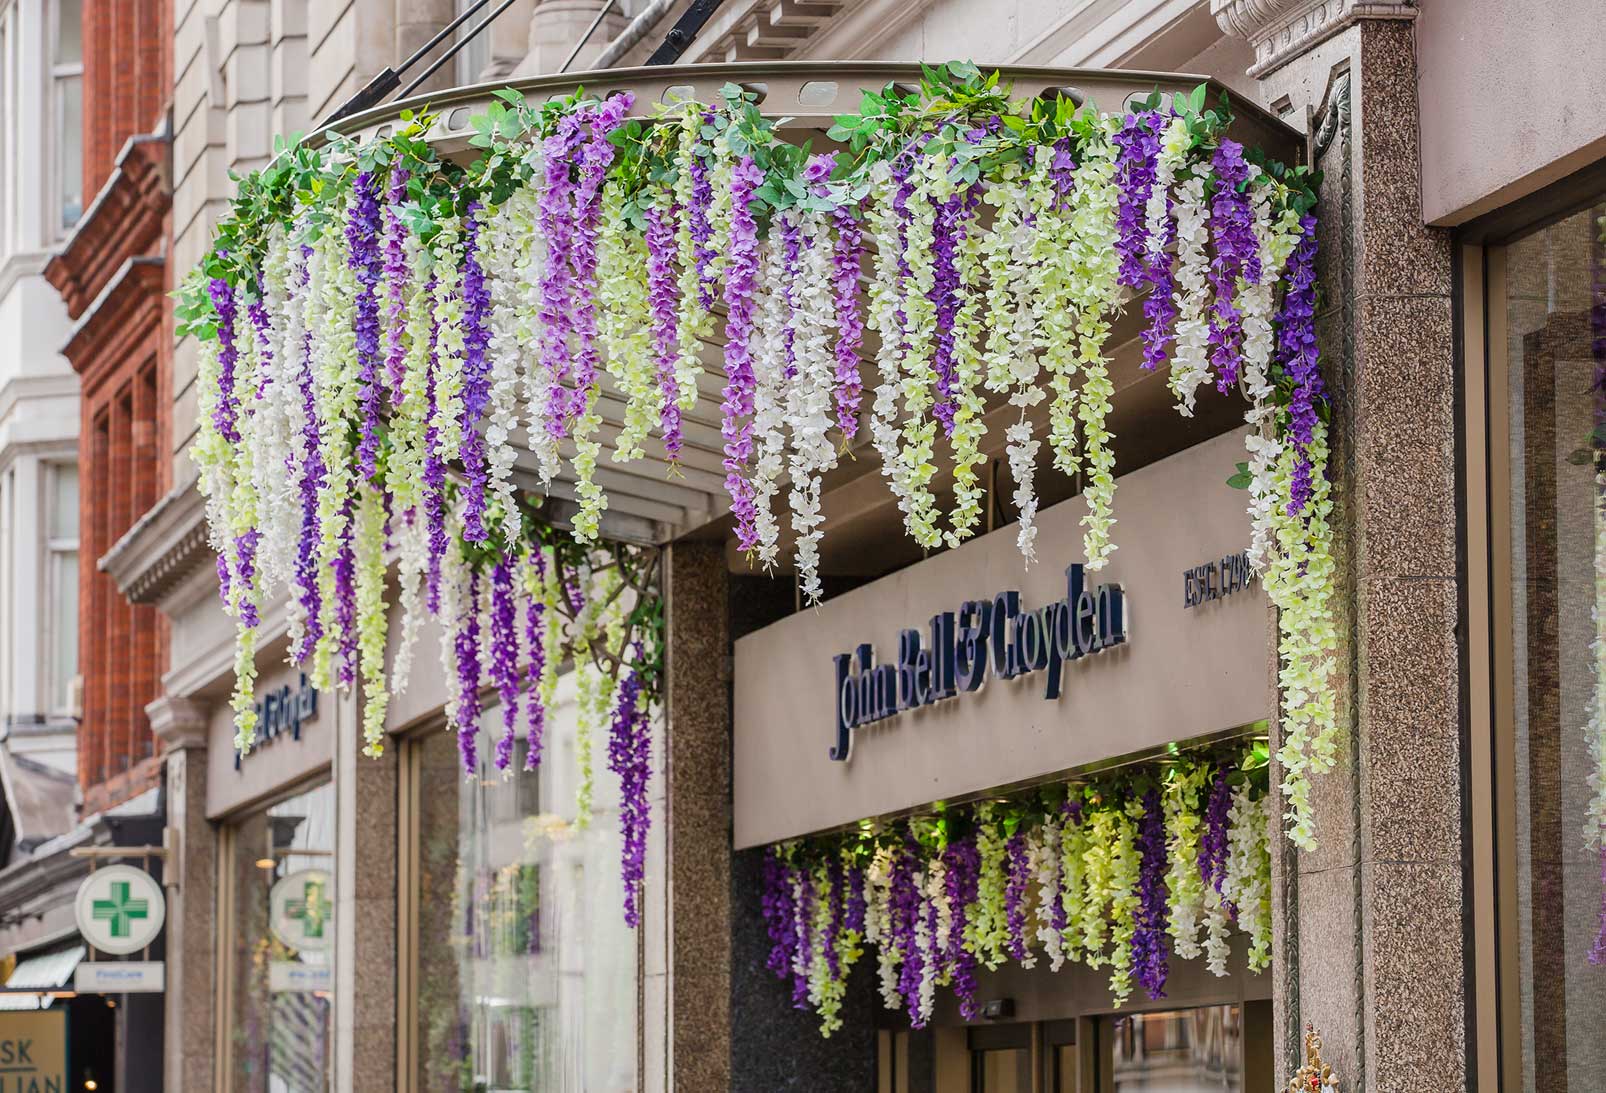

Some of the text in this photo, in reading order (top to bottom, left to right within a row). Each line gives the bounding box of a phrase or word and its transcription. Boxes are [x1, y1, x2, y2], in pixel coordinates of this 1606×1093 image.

[829, 563, 1126, 761] John Bell & Croyden
